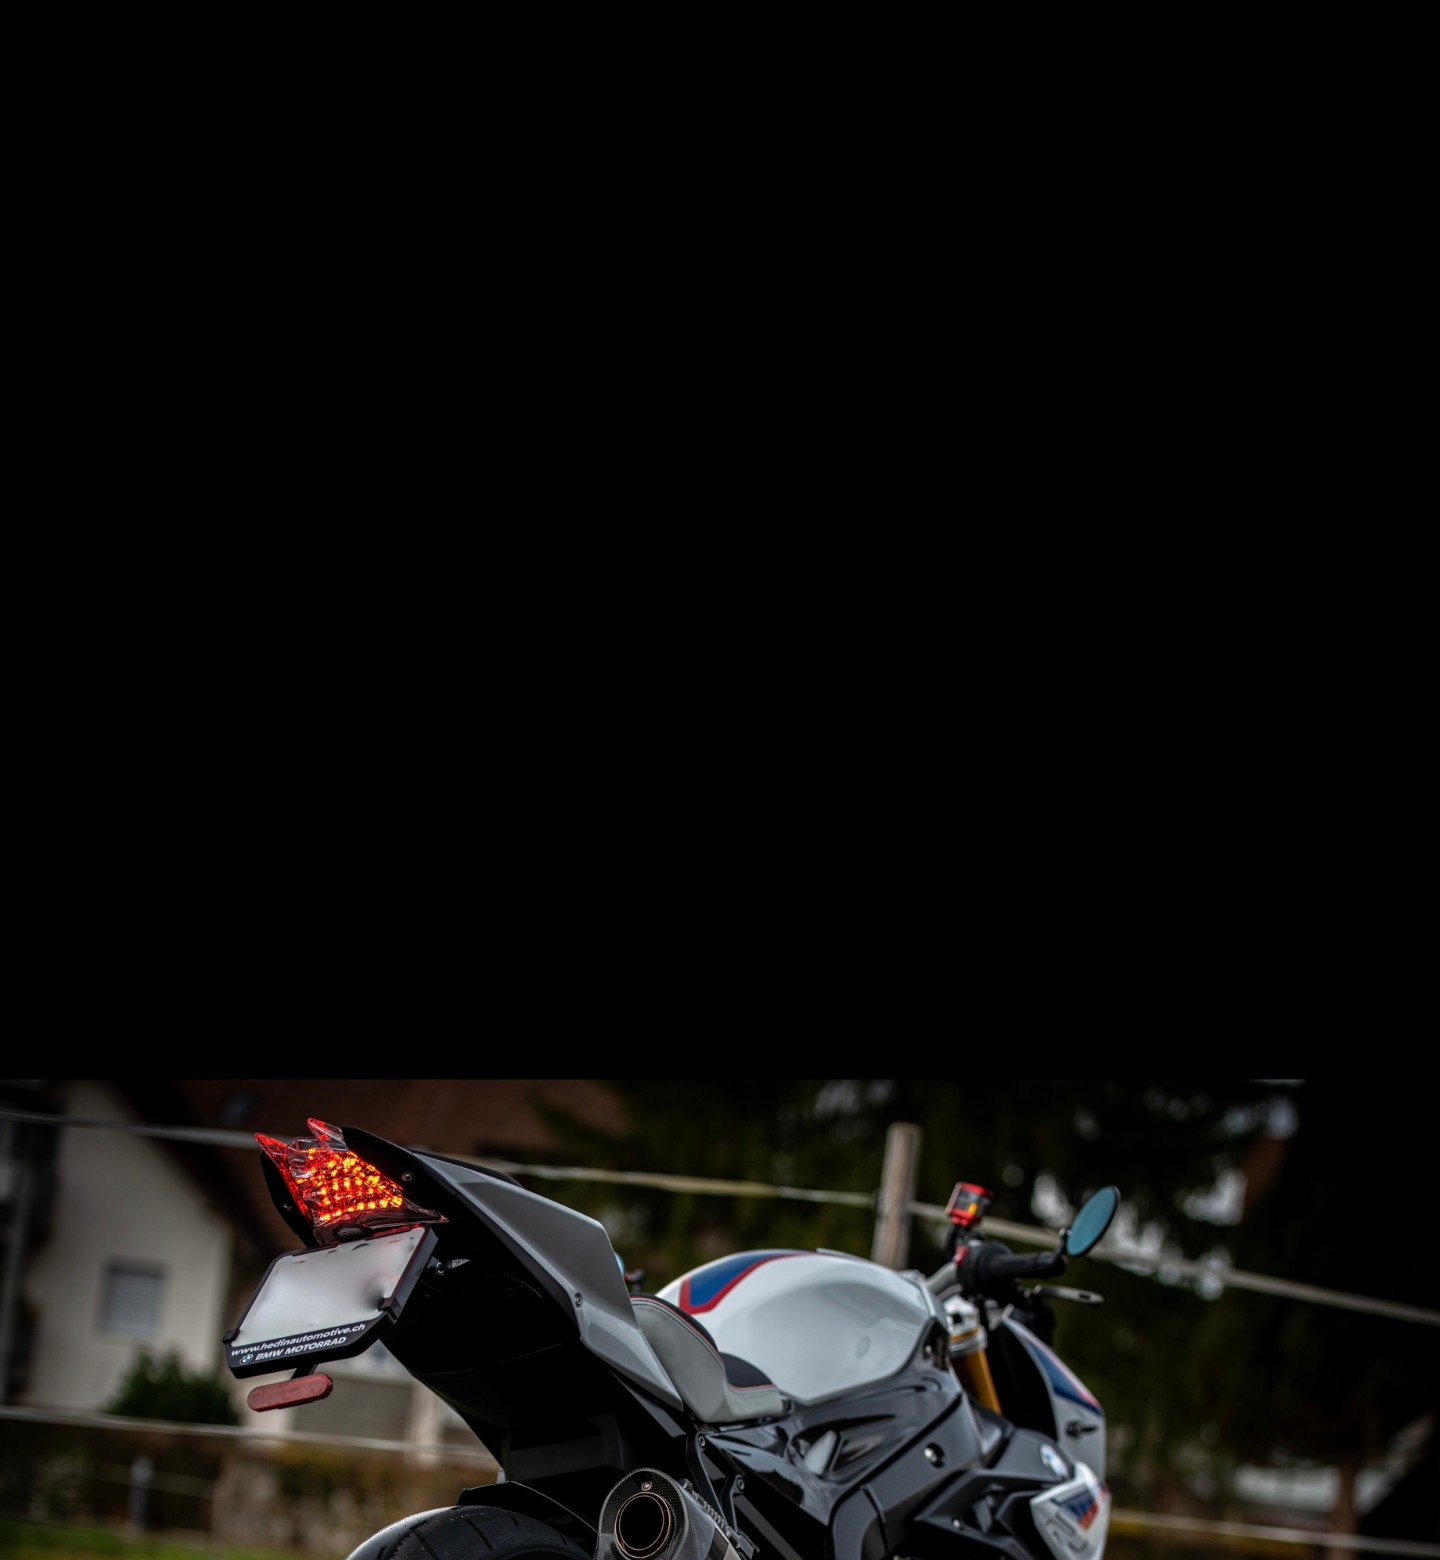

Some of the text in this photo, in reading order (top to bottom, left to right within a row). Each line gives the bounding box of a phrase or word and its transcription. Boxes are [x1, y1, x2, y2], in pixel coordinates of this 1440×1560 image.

[231, 1323, 366, 1357] www.hedinautomotive.ch
[255, 1336, 347, 1361] BMW MOTORRAD
